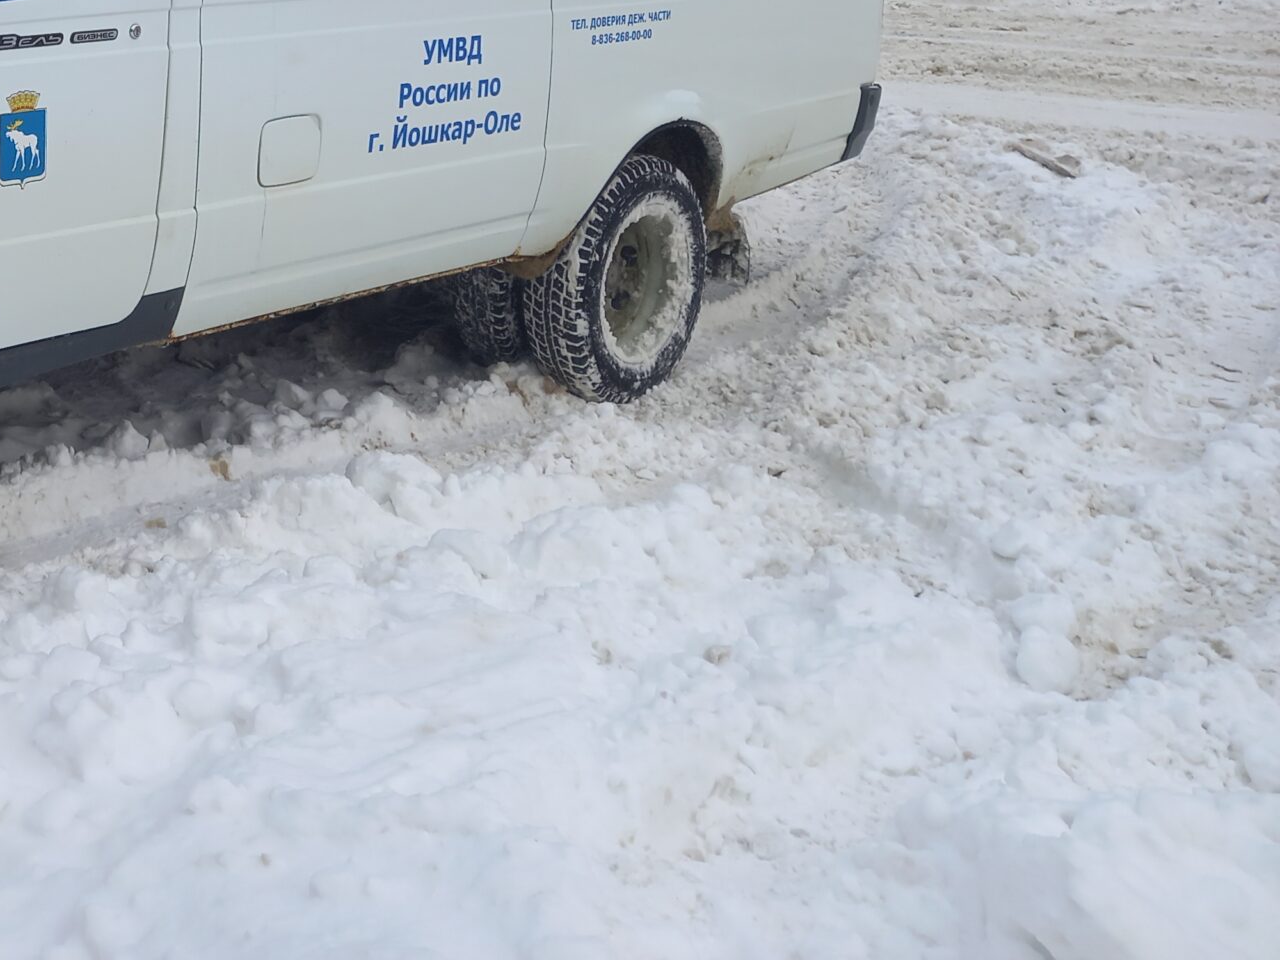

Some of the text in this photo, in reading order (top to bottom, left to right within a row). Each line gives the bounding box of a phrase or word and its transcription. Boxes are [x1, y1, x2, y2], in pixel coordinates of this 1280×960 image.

[571, 9, 672, 31] ТЕЛ. ДОВЕРИЯ ДЕЖ. ЧАСТИ
[77, 30, 116, 42] БИЗНЕС
[591, 28, 653, 46] 8-836-268-00-00
[423, 35, 483, 66] УМВД
[399, 77, 502, 109] России по
[368, 110, 522, 154] г. Йошкар-Оле
